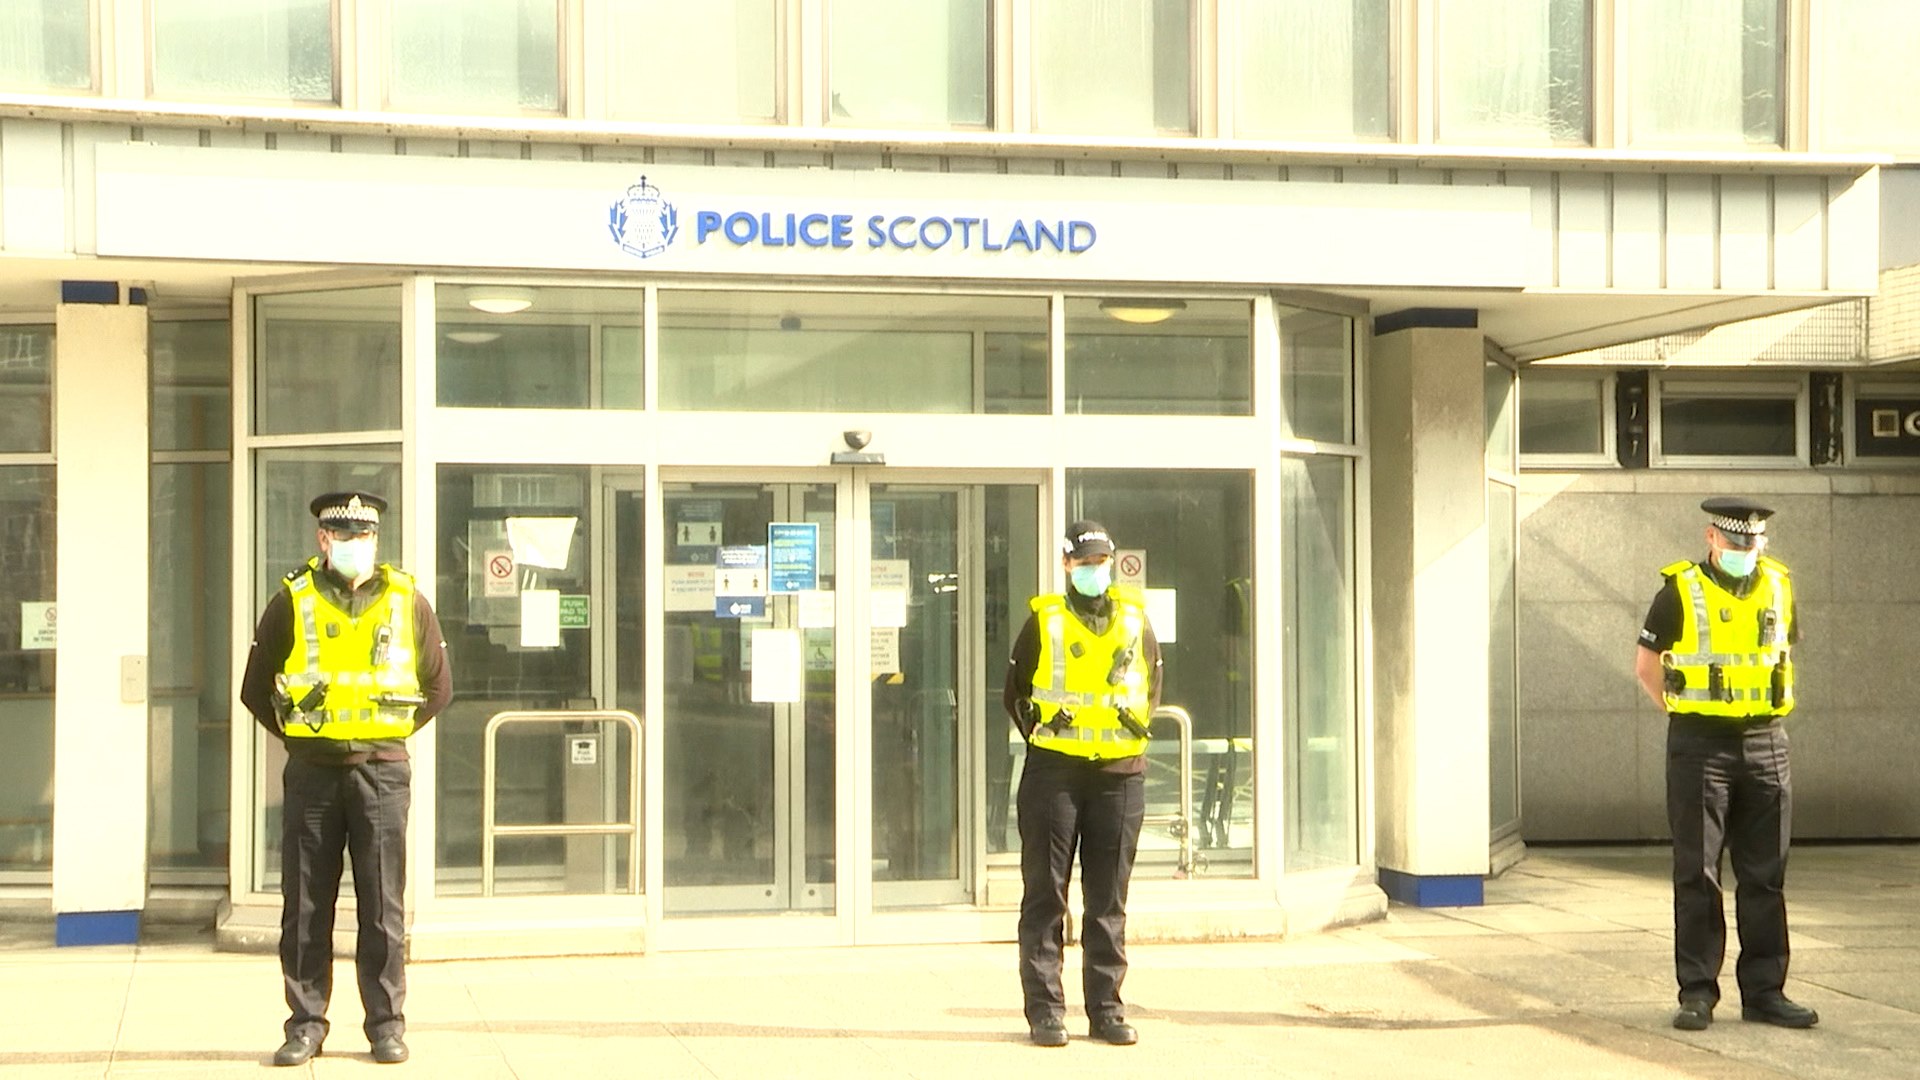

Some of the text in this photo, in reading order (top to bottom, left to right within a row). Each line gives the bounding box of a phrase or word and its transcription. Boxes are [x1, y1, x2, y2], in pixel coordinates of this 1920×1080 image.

[697, 211, 1096, 252] POLICE SCOTLAND
[563, 599, 584, 607] PUSH
[563, 615, 584, 623] OPEN
